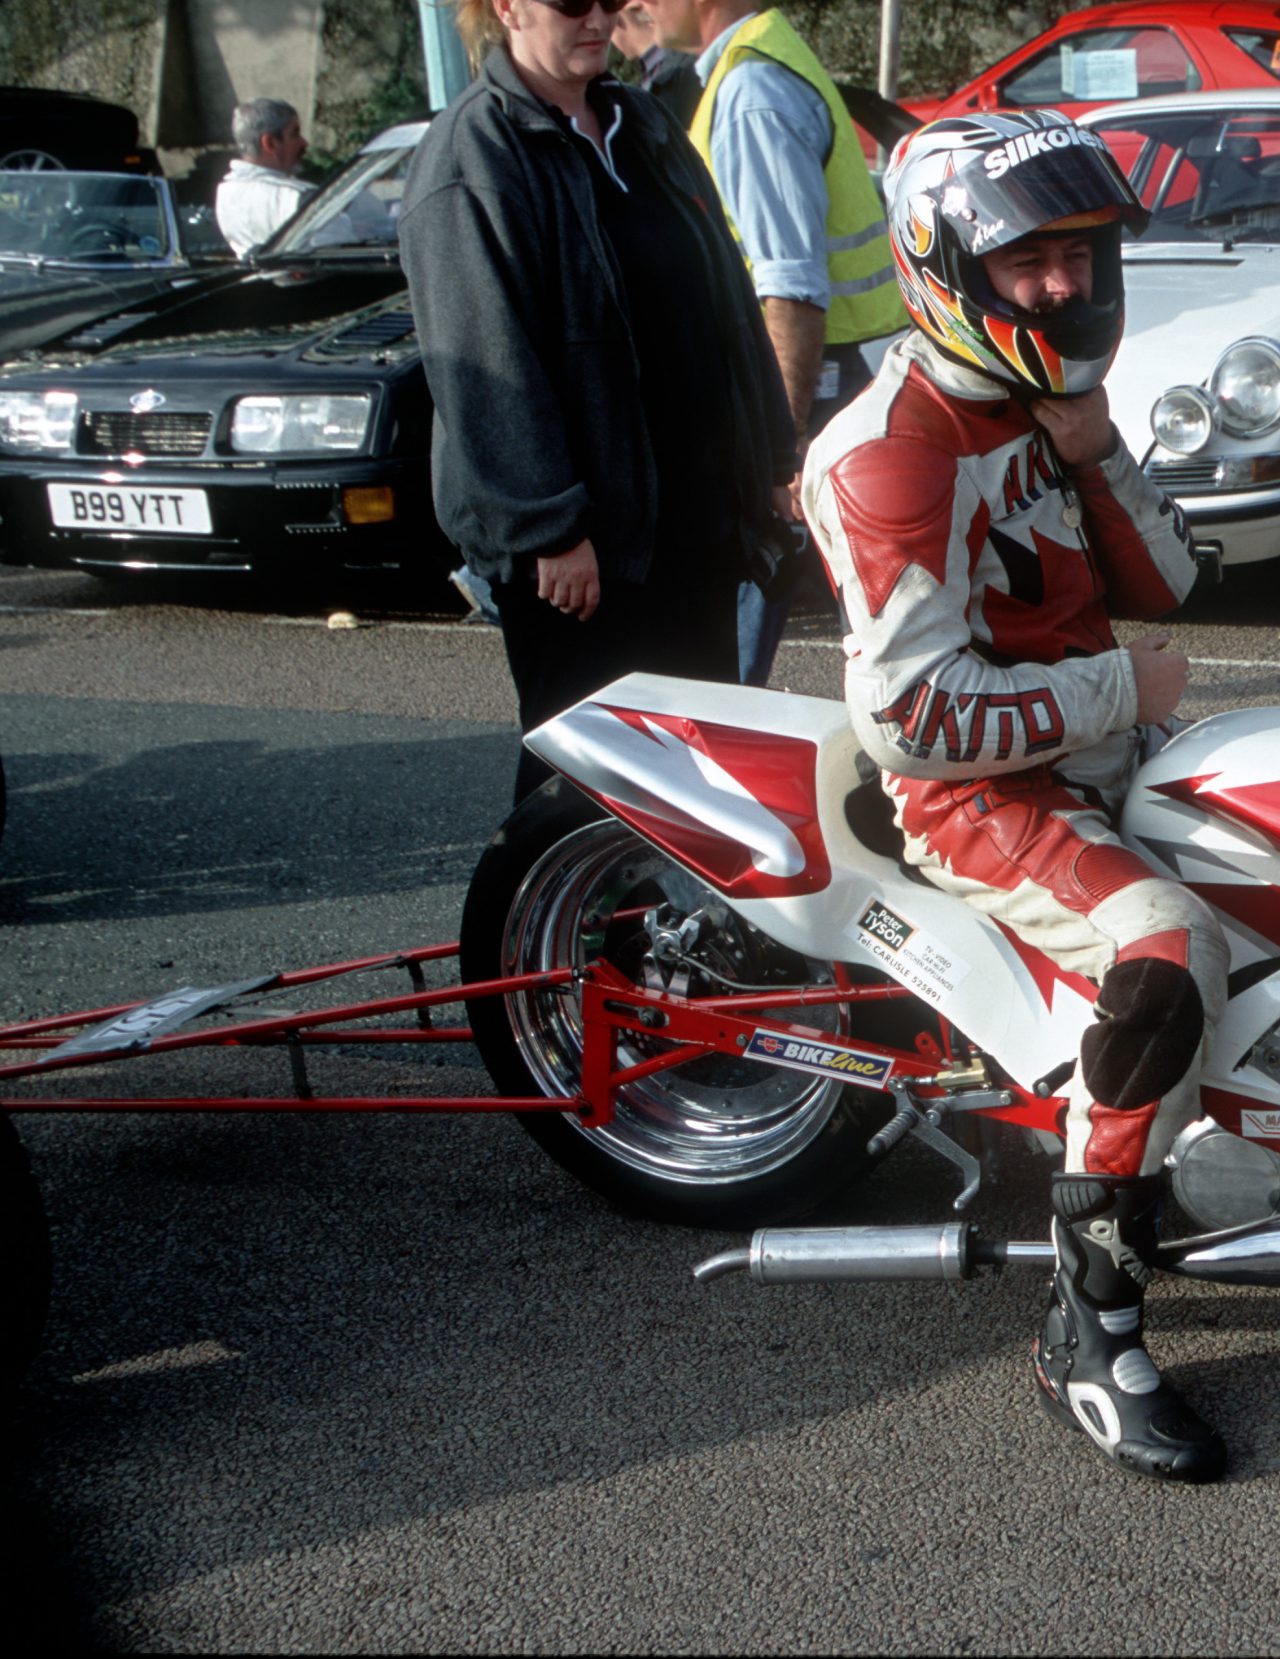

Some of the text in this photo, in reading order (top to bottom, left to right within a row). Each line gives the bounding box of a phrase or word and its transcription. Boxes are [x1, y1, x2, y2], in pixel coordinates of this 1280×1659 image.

[70, 490, 183, 526] B99 YTT
[870, 679, 1065, 763] AKITO
[865, 910, 904, 948] Tyson
[878, 909, 903, 931] Peter
[858, 932, 942, 1002] Tel: CARLISLE 525891
[921, 953, 934, 965] CAR
[934, 953, 952, 969] VIDEO
[923, 964, 955, 992] APPLIANCES
